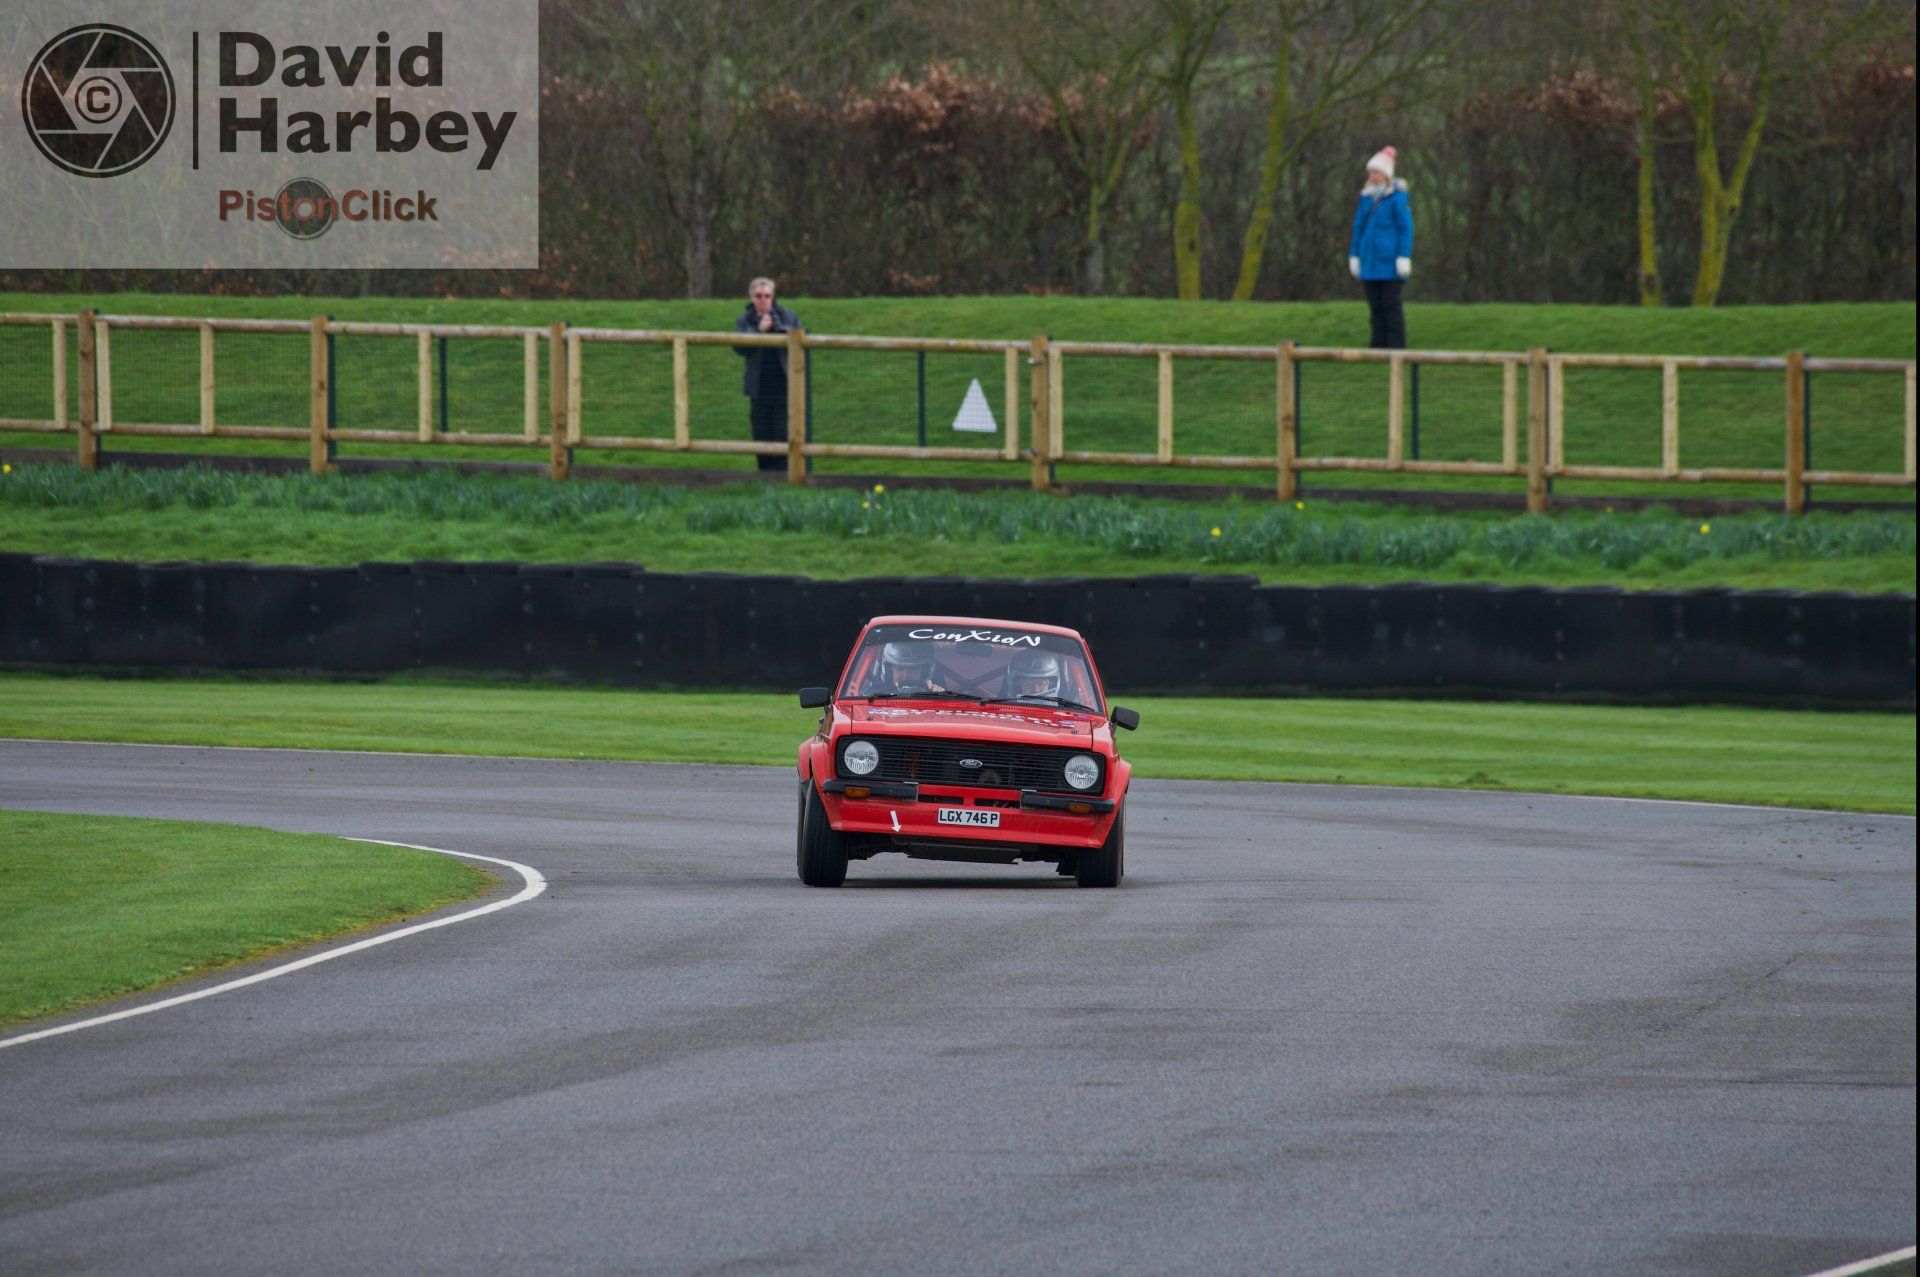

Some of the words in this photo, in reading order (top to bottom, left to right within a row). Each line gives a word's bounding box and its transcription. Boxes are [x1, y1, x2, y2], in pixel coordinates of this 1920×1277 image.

[939, 810, 963, 822] LGX
[966, 812, 988, 824] 746
[990, 813, 998, 824] P
